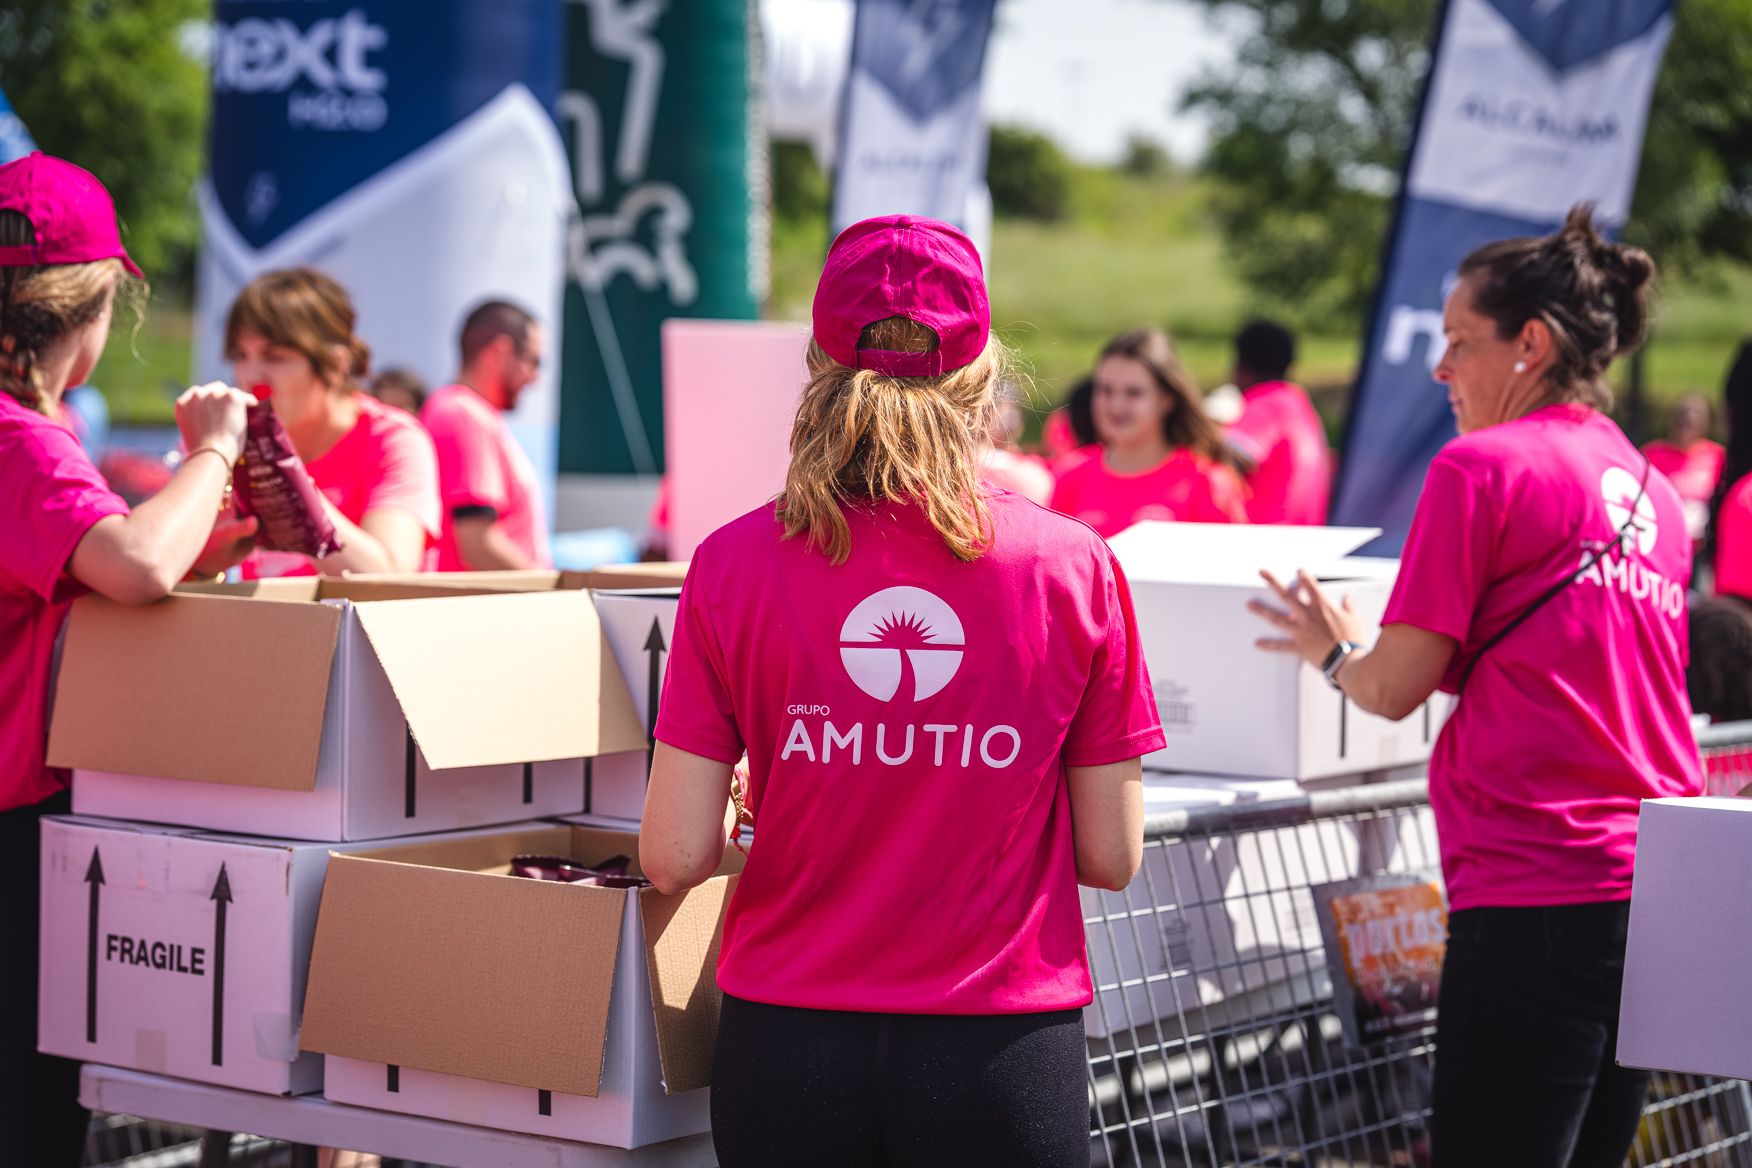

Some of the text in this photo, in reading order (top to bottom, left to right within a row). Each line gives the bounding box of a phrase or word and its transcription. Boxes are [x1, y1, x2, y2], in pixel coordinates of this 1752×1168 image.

[1575, 550, 1684, 620] AMUTIO
[787, 704, 830, 716] GRUPO
[781, 719, 1021, 769] AMUTIO
[106, 933, 206, 976] FRAGILE
